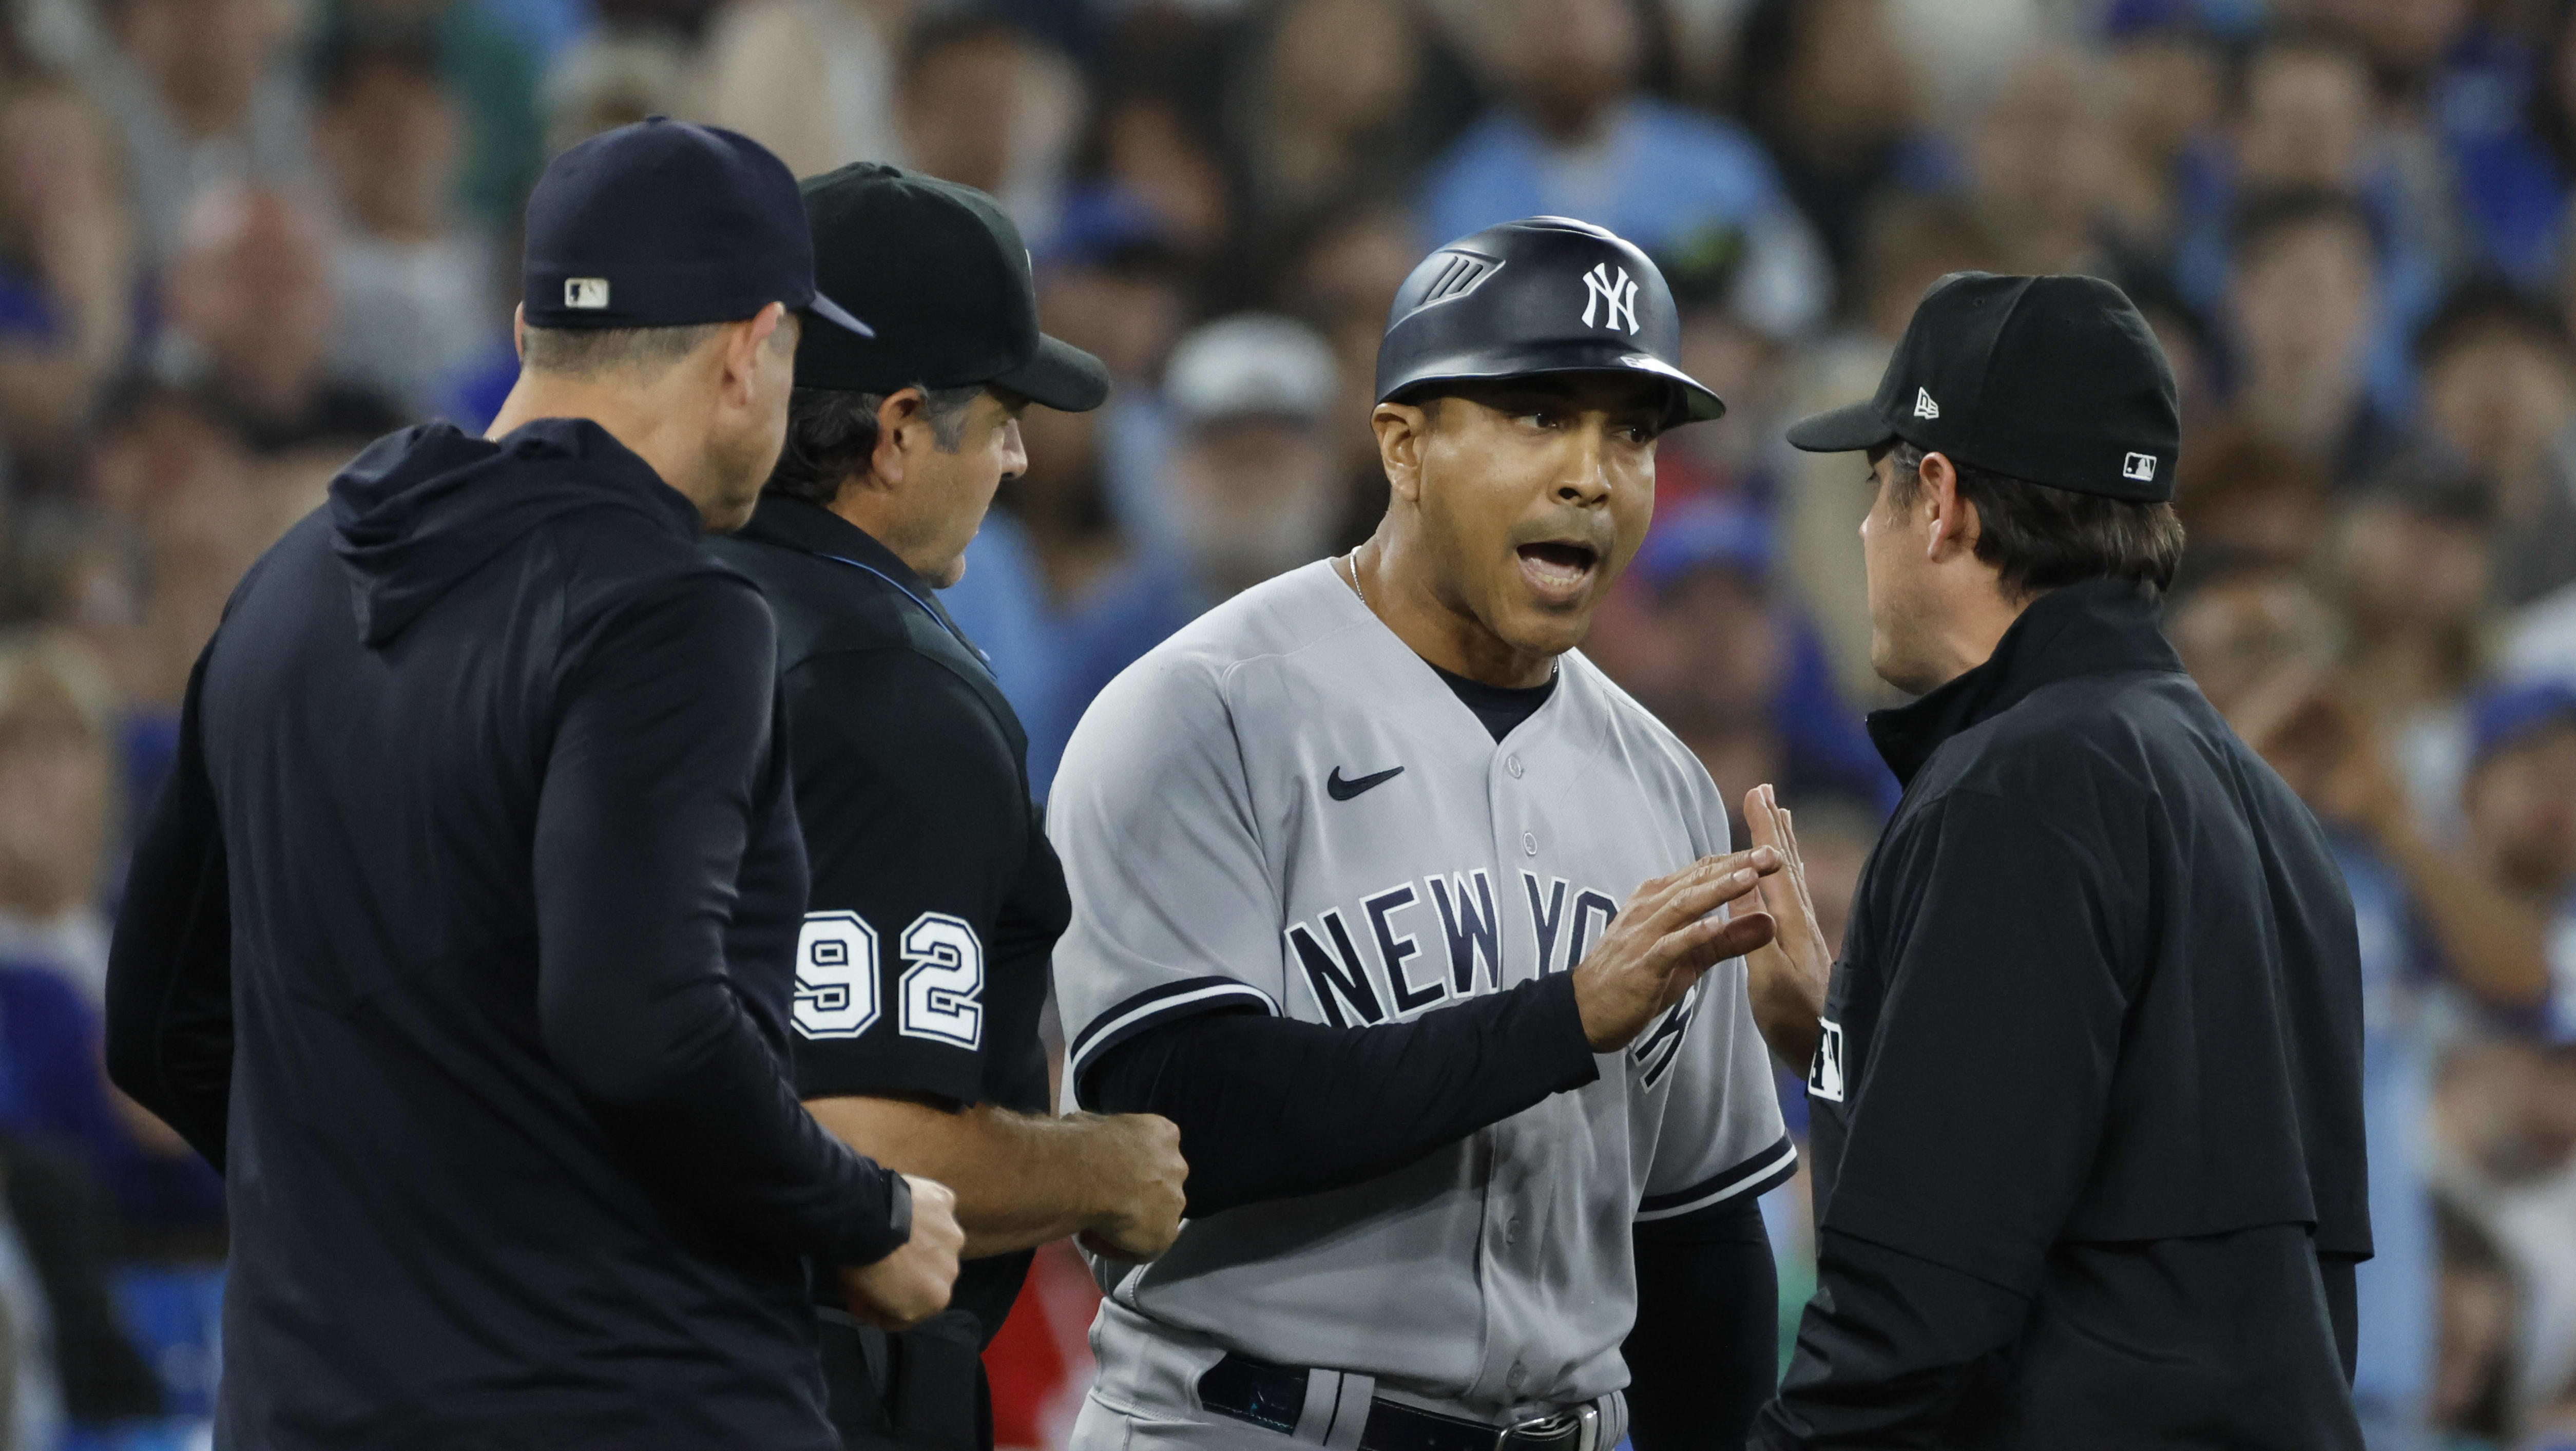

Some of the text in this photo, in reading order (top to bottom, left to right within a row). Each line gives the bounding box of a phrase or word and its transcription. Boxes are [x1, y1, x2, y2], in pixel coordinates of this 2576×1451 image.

[1582, 262, 1640, 335] NY
[791, 910, 985, 1052] 92
[1284, 867, 1702, 1094] NEW YOK
